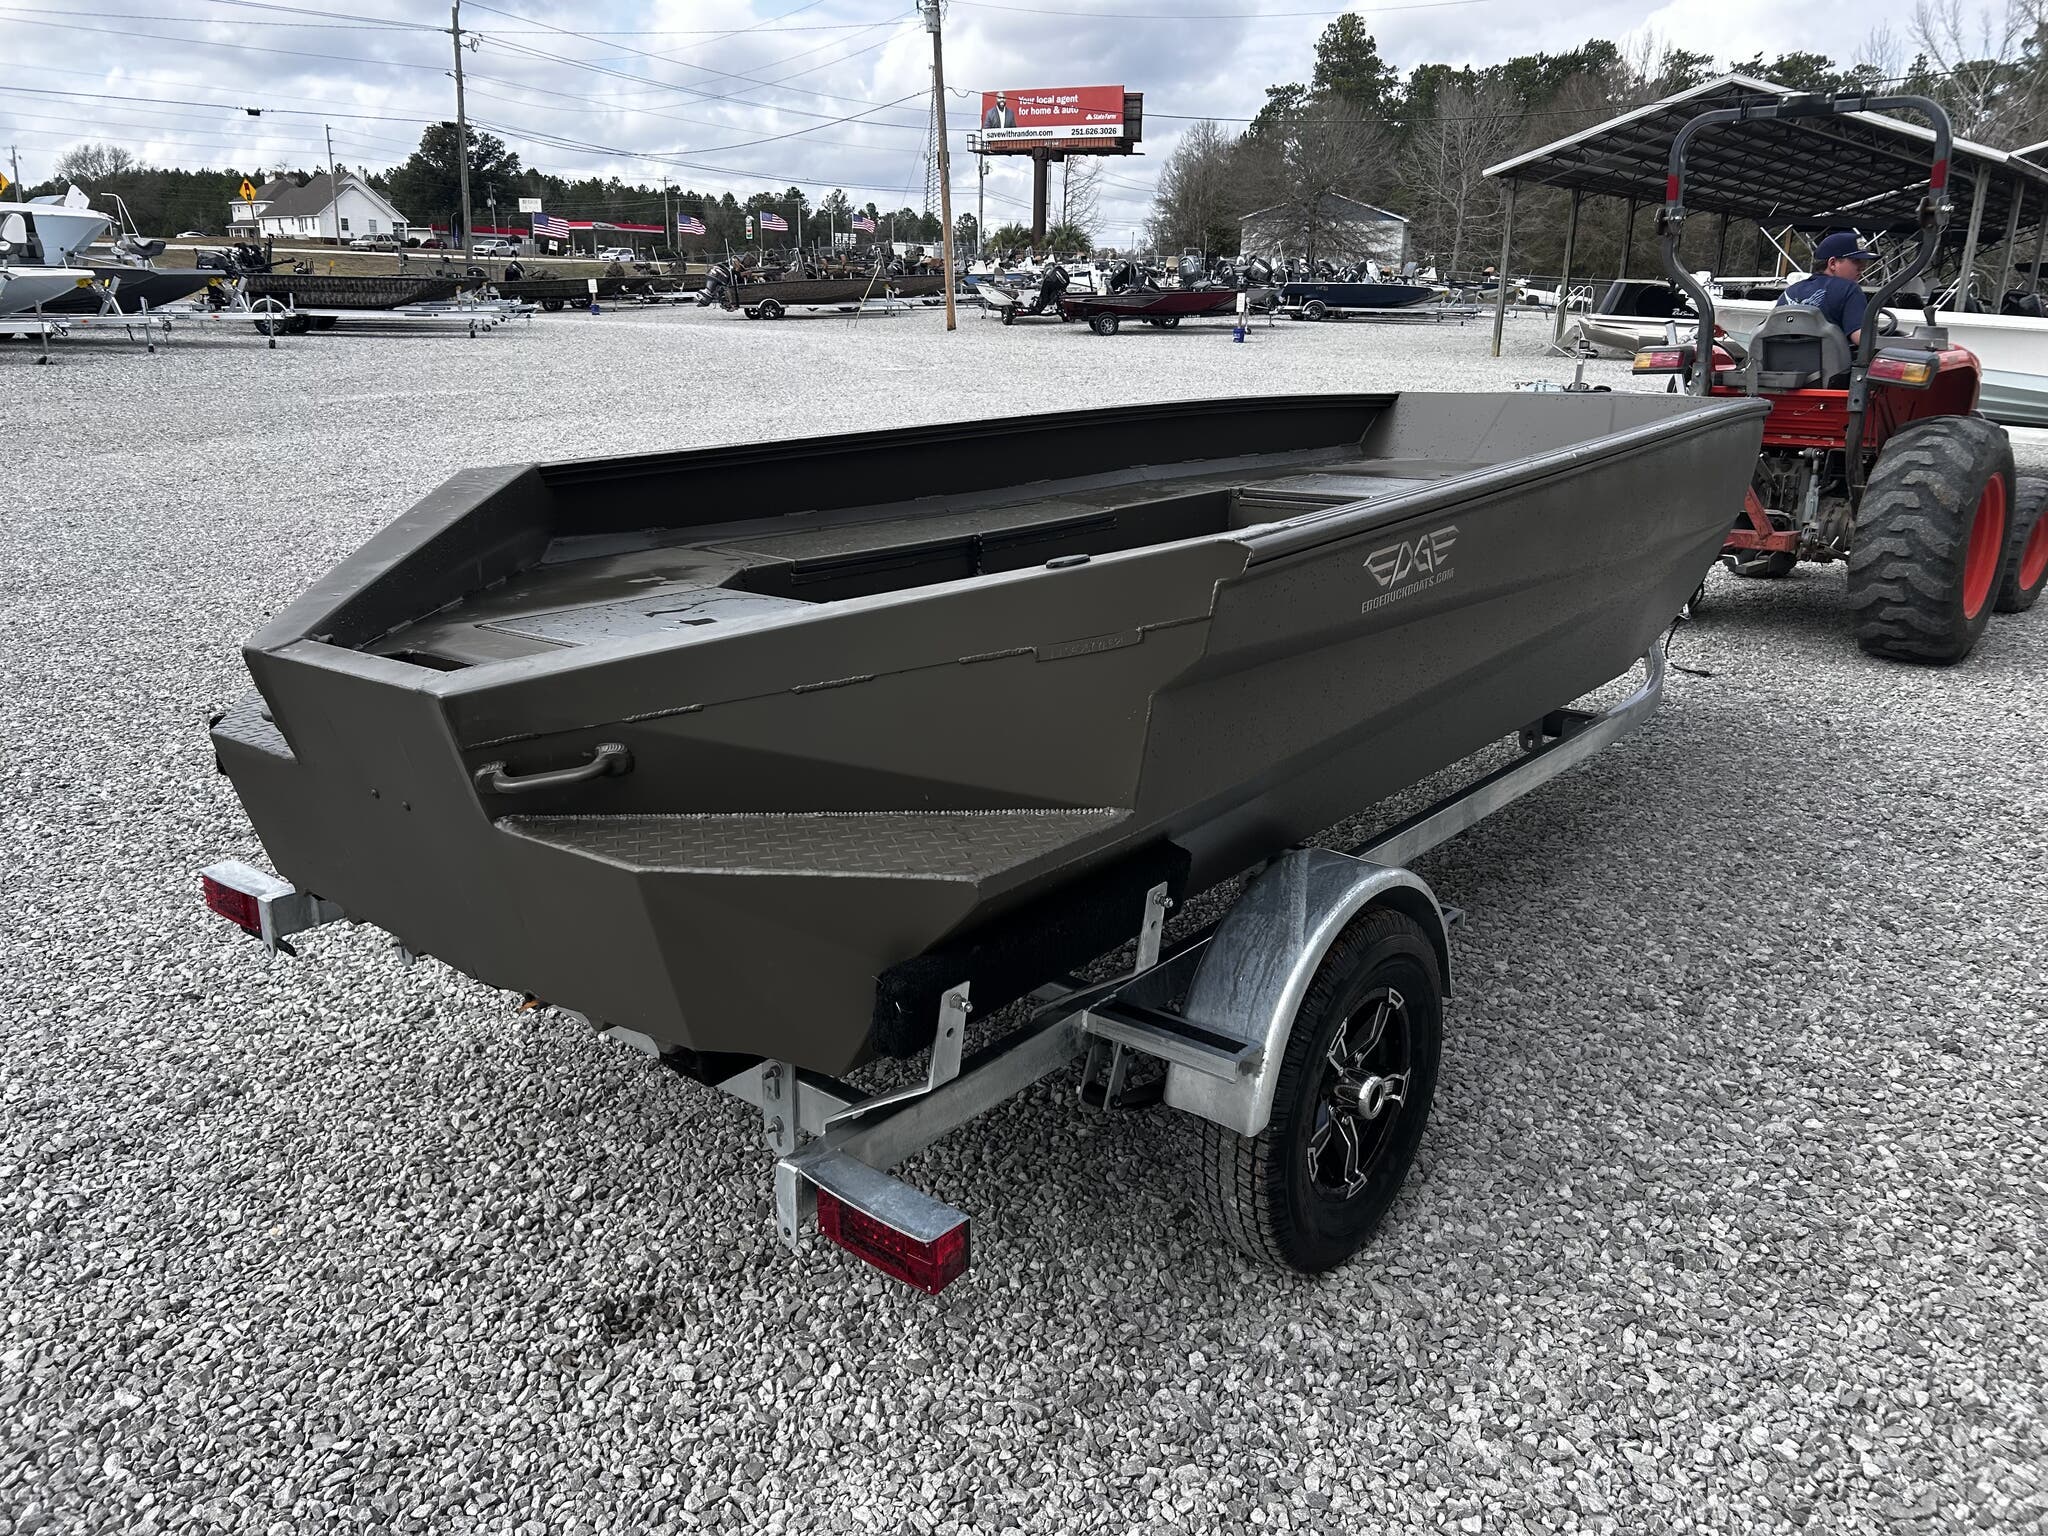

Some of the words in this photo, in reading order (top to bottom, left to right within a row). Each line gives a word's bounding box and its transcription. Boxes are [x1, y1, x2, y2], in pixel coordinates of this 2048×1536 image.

[1018, 96, 1035, 105] Your
[1036, 95, 1055, 104] local
[1056, 94, 1079, 105] agent
[1018, 106, 1030, 116] for
[1030, 106, 1052, 115] home
[1053, 105, 1060, 114] &
[1061, 105, 1079, 114] auto
[986, 129, 1054, 139] savewithrandon.com
[1071, 127, 1117, 136] 251.626.3026
[1362, 525, 1460, 589] EDGE
